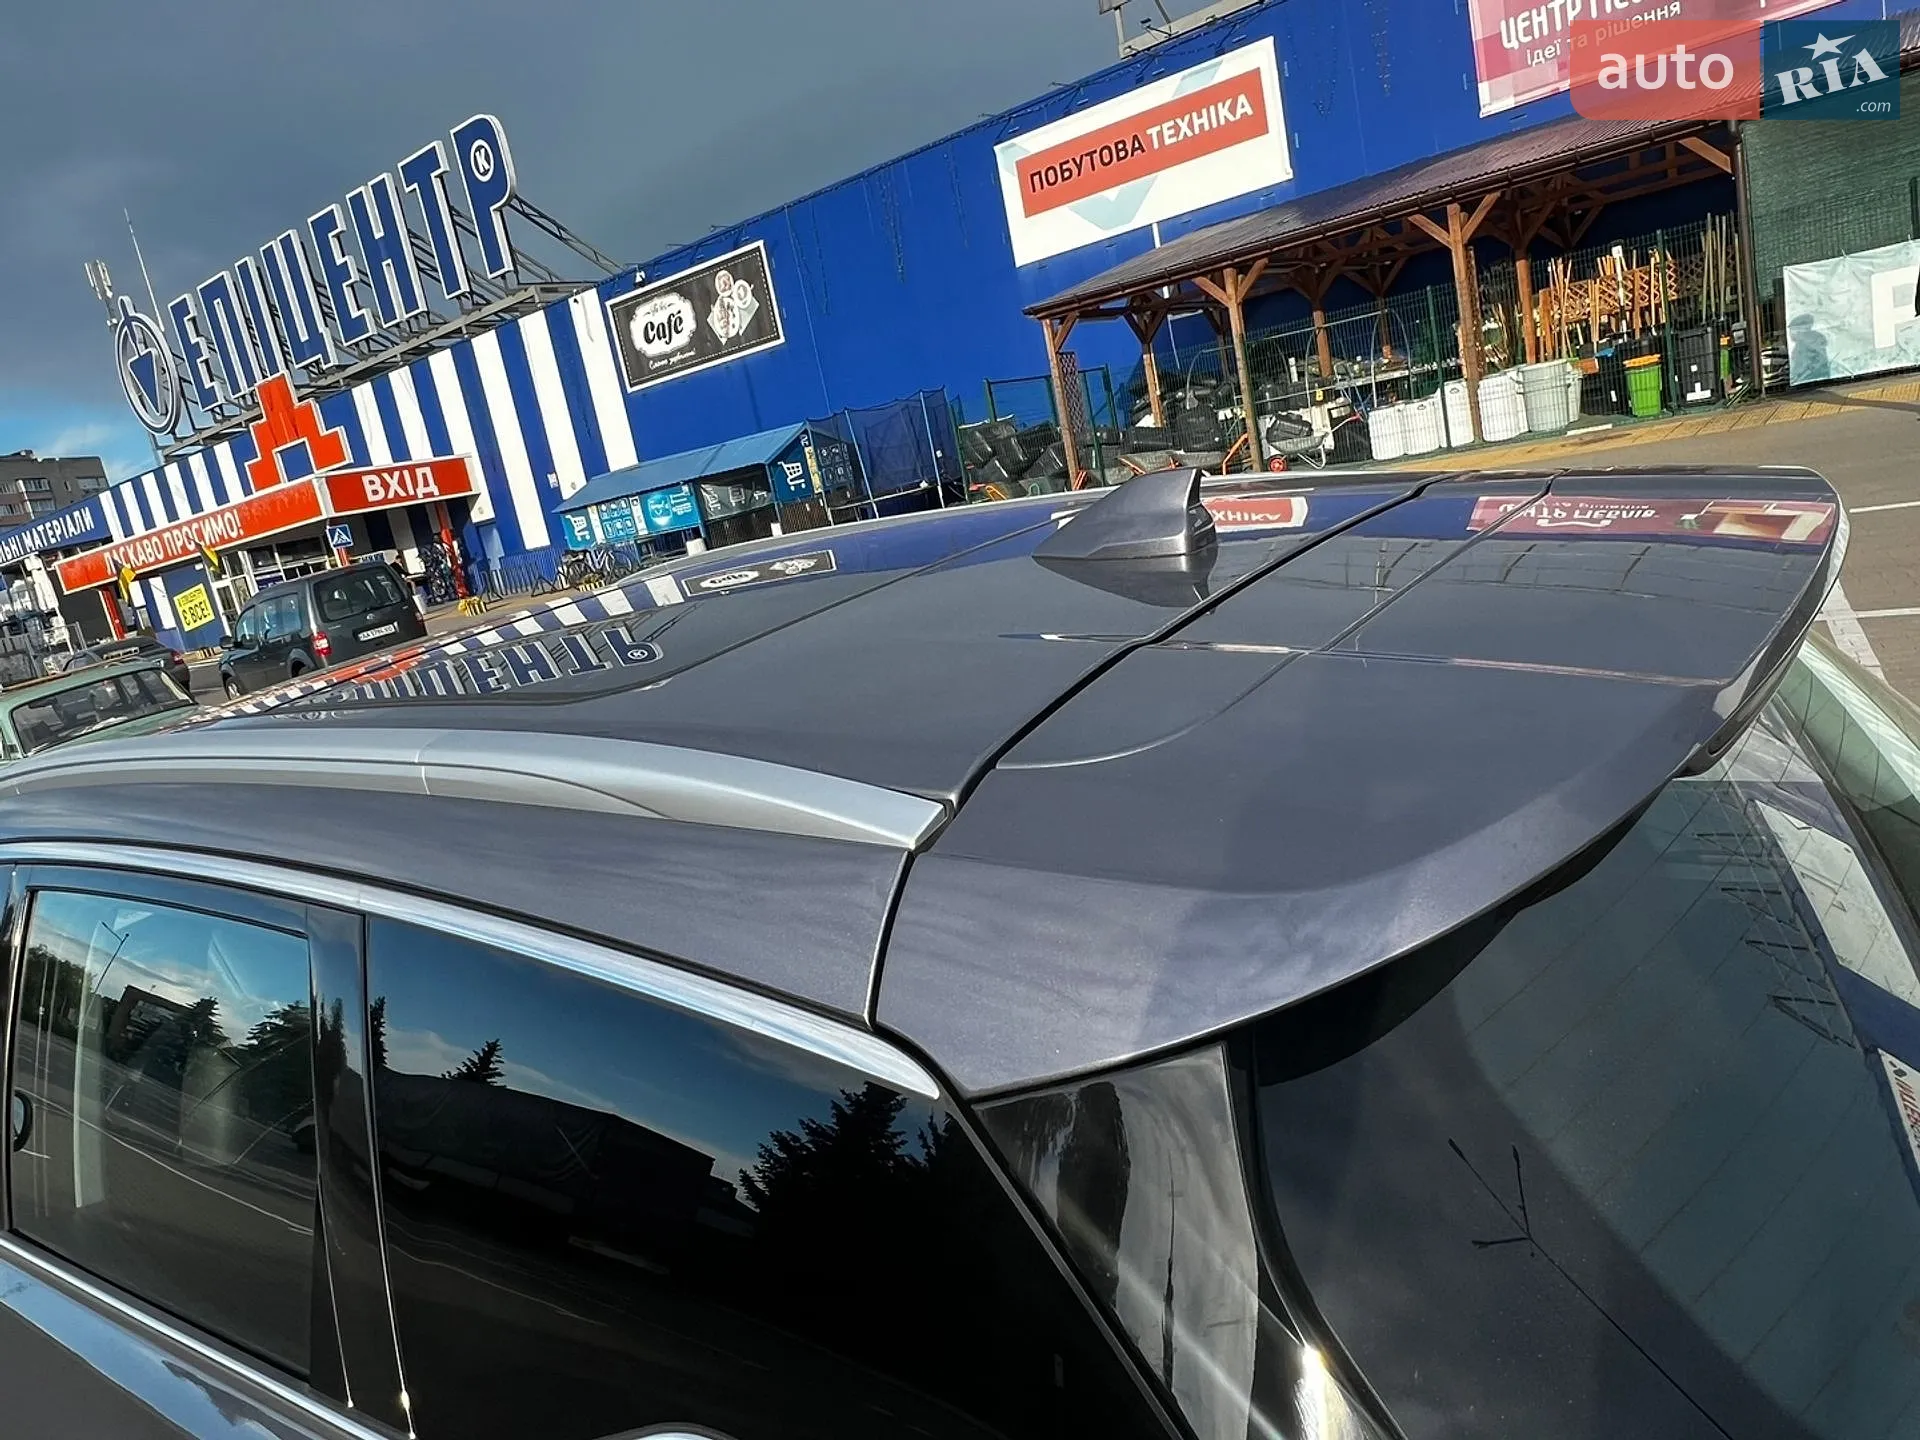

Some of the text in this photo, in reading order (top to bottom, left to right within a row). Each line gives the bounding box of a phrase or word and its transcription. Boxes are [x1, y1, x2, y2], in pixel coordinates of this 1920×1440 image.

[1501, 0, 1582, 50] ЦЕНТР
[1526, 38, 1561, 67] ідеї
[1595, 1, 1682, 47] рішення
[1029, 93, 1254, 193] ПОБУТОВА ТЕХНІКА
[168, 114, 517, 413] ЕПІЦЕНТР
[361, 466, 440, 502] ВХІД
[21, 506, 95, 553] МАТЕРІАЛИ
[165, 508, 245, 559] ПРОСИМО!
